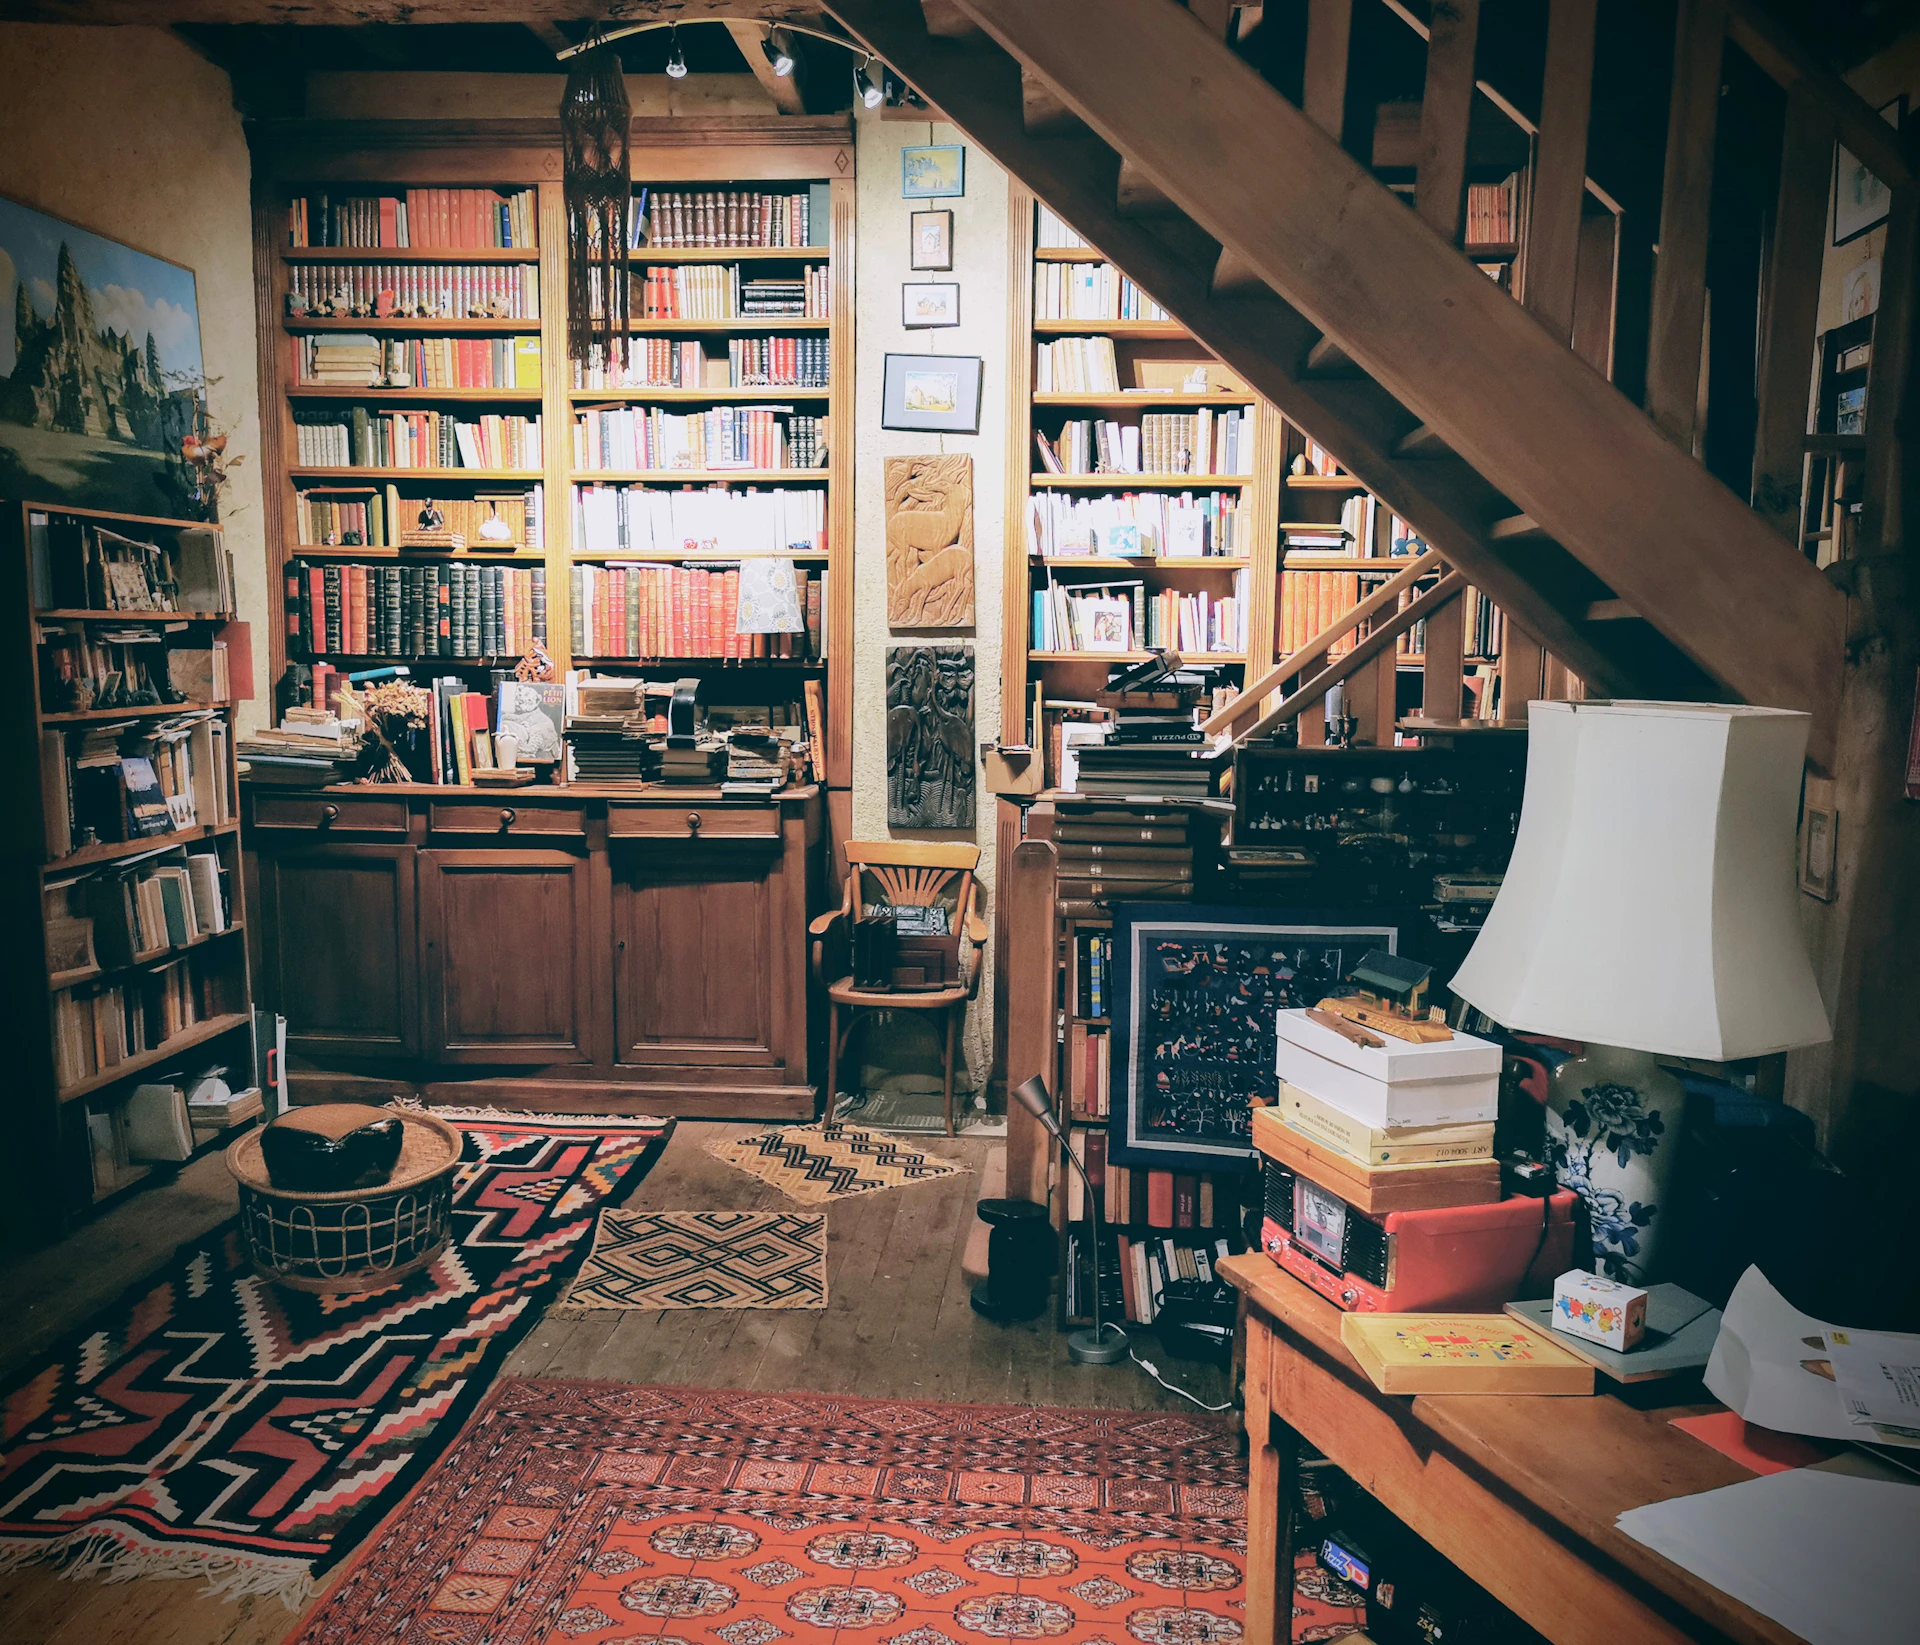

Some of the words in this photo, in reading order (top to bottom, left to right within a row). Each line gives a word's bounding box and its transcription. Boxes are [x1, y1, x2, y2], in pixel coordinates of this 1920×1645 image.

[1471, 1146, 1489, 1154] ART
[1475, 1324, 1505, 1334] Dorf
[1416, 1616, 1434, 1632] 254
